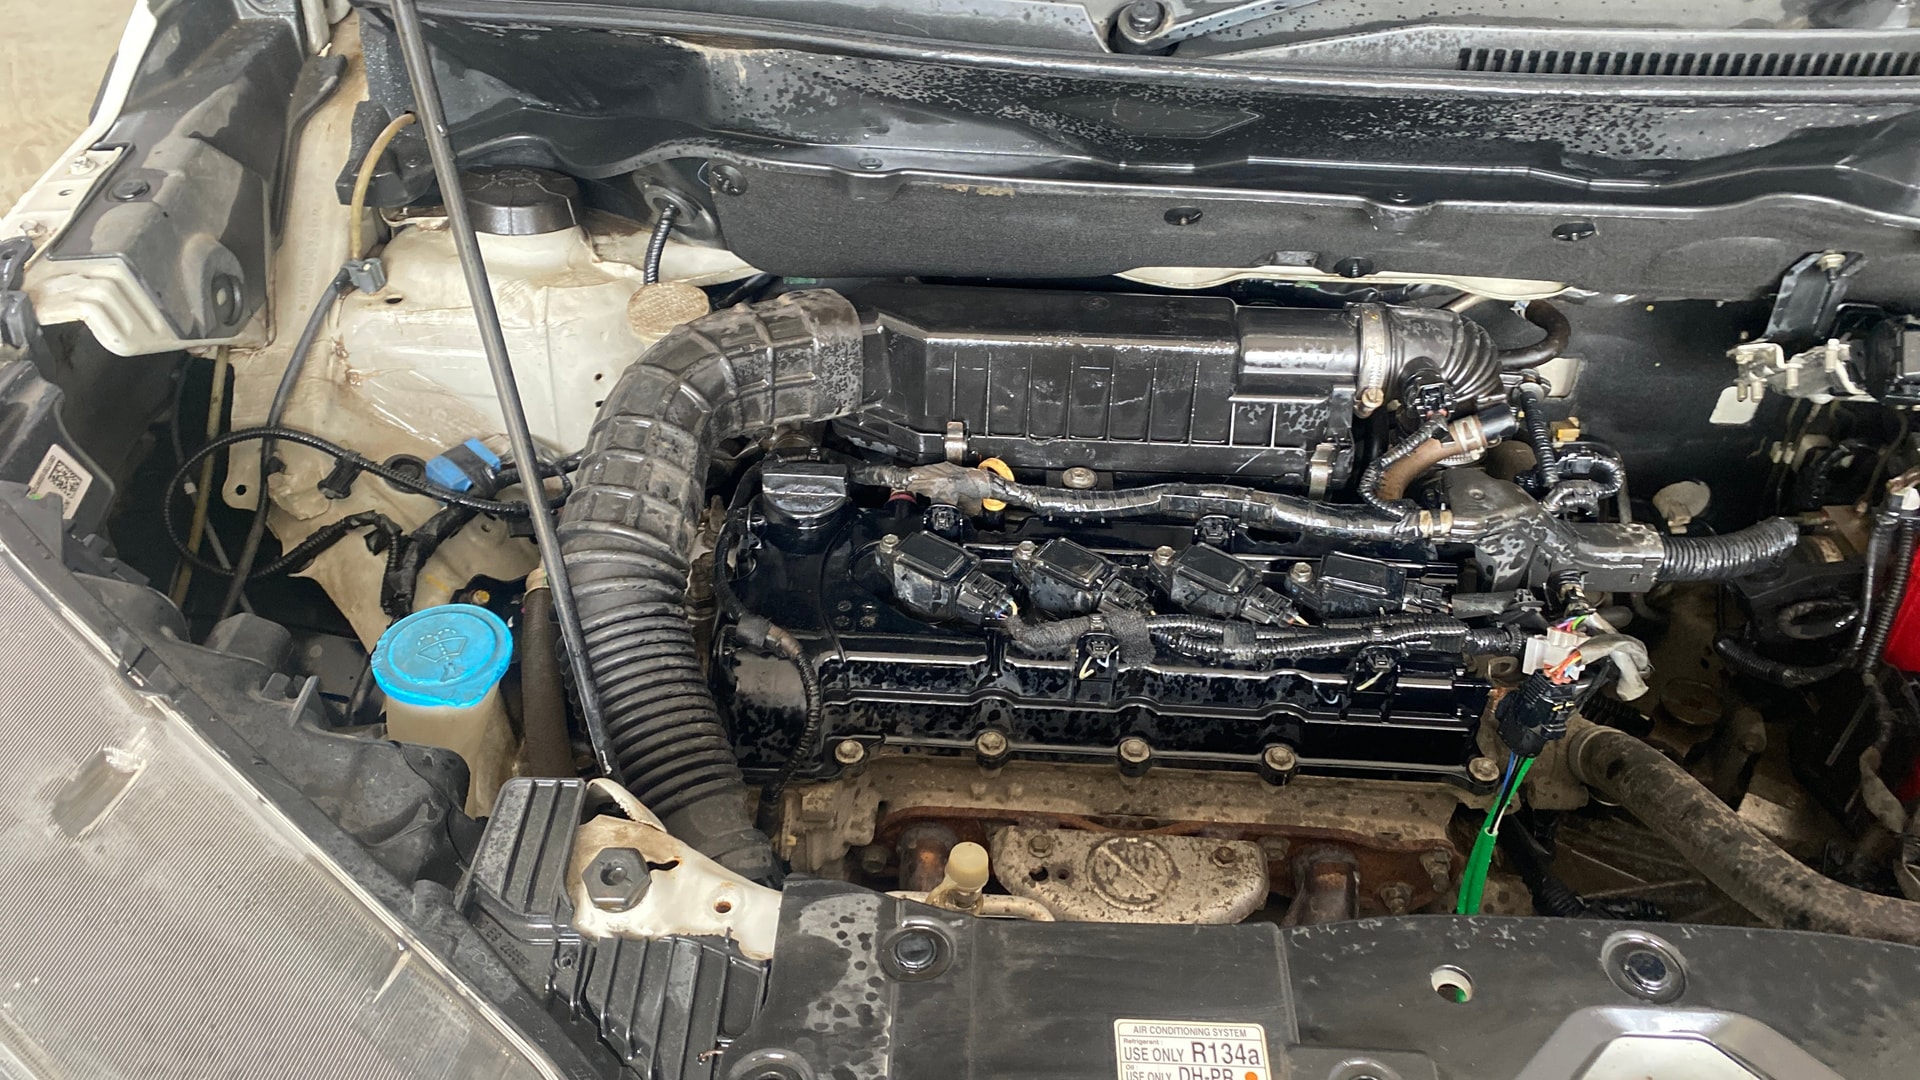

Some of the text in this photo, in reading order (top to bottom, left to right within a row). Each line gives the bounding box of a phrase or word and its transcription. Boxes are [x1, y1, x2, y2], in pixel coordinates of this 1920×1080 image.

[1133, 1025, 1247, 1037] AIR CONDITIONING SYSTEM
[1124, 1041, 1260, 1065] USE ONLY R134a
[1126, 1071, 1145, 1080] USE
[1147, 1071, 1172, 1080] ONLY
